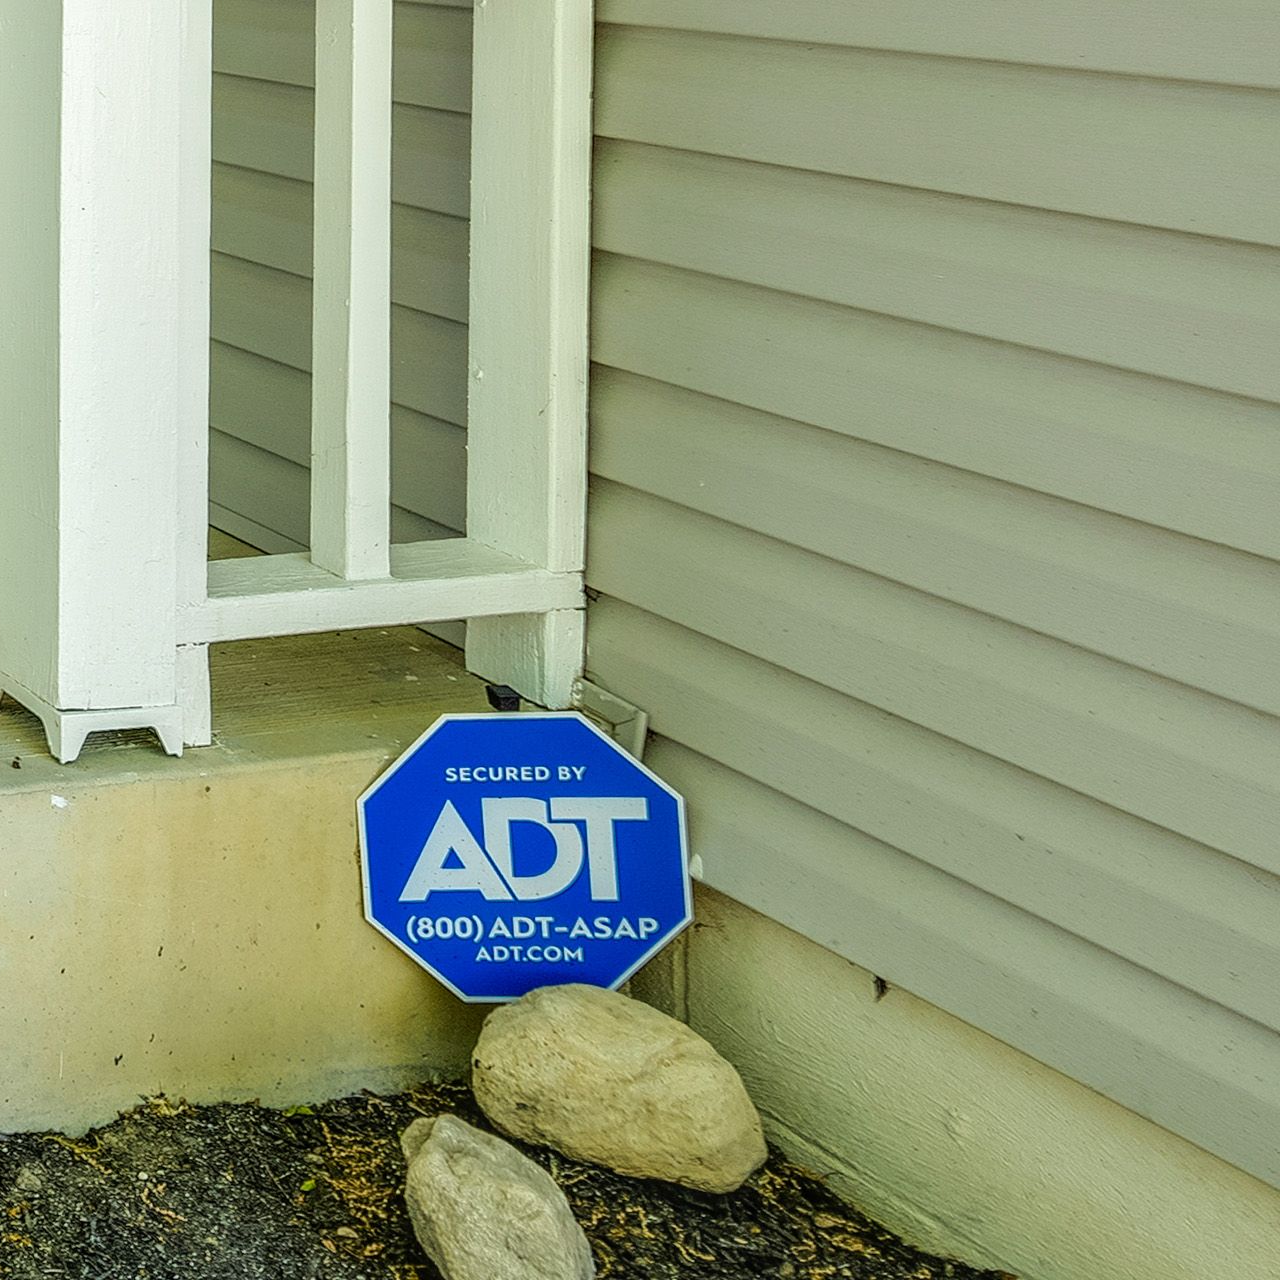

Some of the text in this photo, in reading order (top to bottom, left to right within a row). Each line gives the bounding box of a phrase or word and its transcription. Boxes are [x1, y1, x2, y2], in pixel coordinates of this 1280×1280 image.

[445, 766, 587, 783] SECURED BY
[397, 796, 650, 902] ADT
[406, 915, 660, 944] (800) ADT-ASAP
[475, 945, 584, 962] ADT.COM
